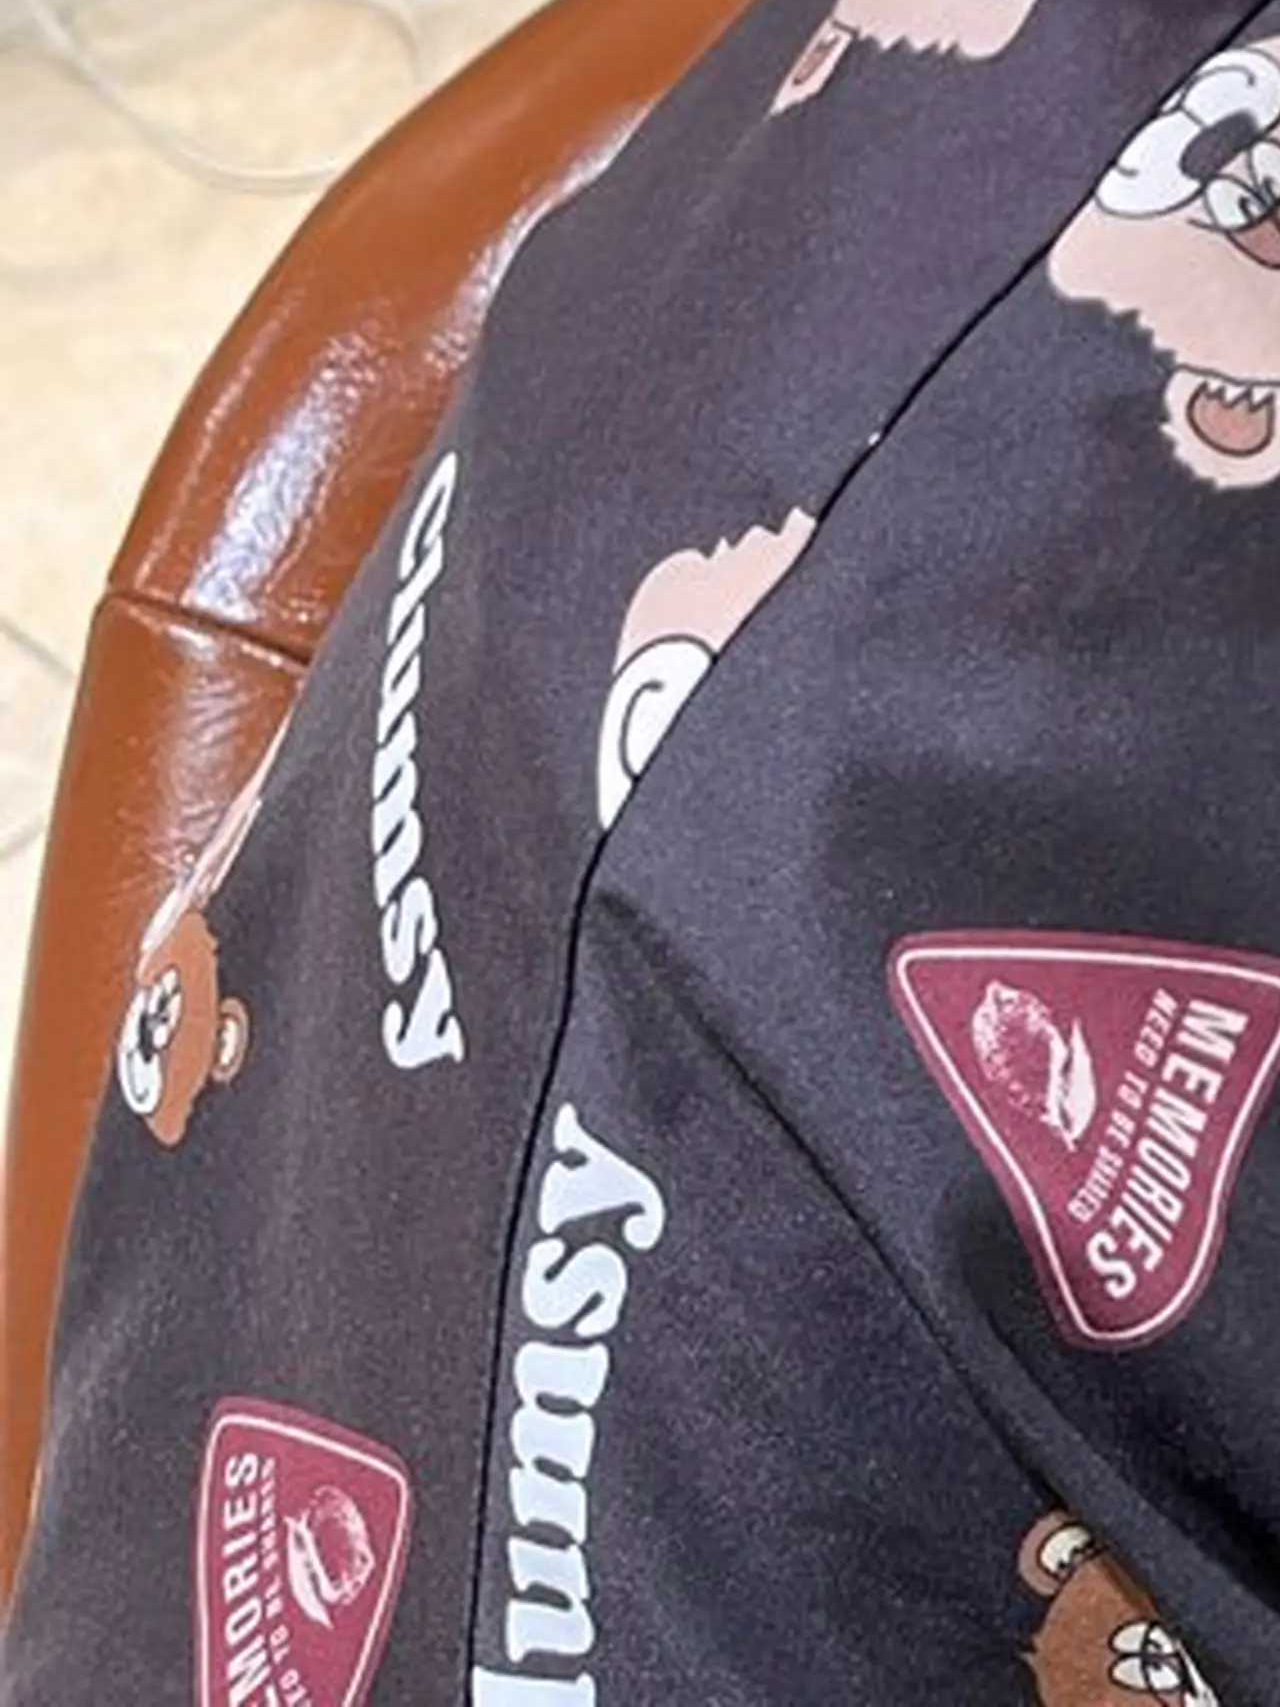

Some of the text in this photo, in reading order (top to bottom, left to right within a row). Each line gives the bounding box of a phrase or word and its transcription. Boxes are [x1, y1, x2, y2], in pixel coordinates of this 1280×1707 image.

[372, 451, 464, 1069] Clumsy
[1117, 1070, 1149, 1109] TO
[1133, 988, 1178, 1067] NEED
[1086, 998, 1250, 1300] MEMORIES
